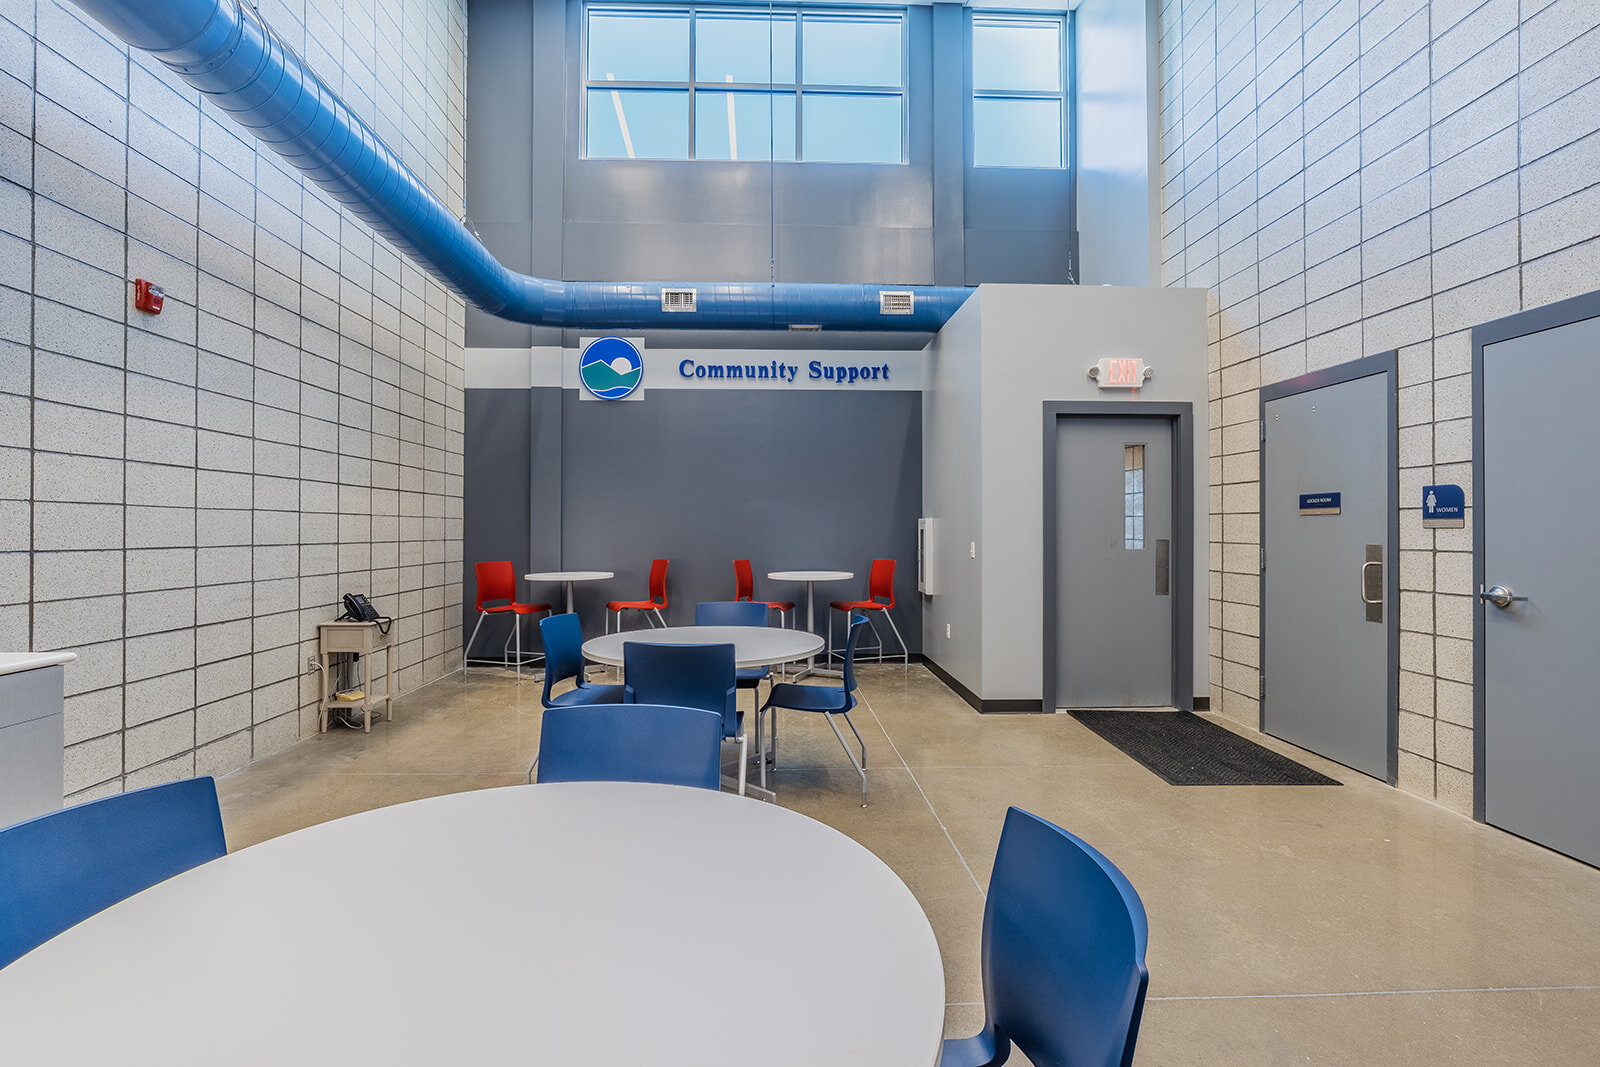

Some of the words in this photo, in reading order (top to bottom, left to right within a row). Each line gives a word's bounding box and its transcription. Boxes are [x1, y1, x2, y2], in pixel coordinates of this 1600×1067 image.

[678, 359, 798, 382] Community
[808, 360, 890, 383] Support
[1108, 359, 1138, 383] EXIT
